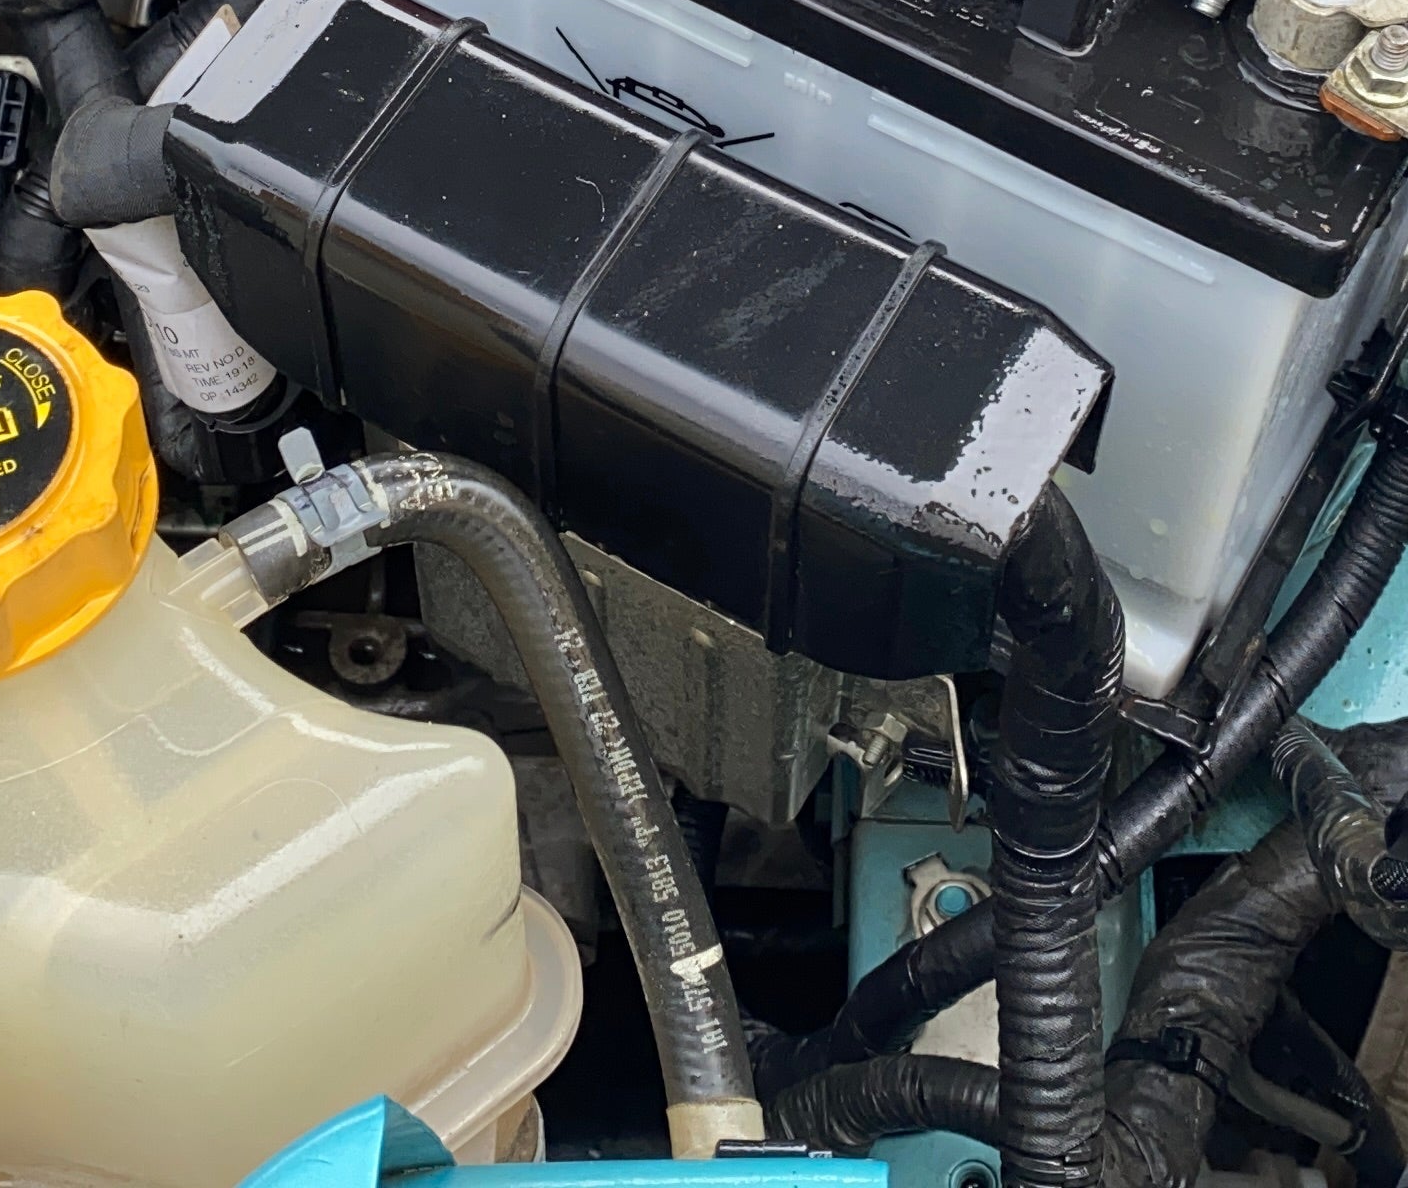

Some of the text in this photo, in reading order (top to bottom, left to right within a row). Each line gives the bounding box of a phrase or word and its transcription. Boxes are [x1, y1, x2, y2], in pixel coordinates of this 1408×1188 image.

[3, 347, 56, 403] CLOSE
[185, 361, 210, 374] REV
[650, 855, 680, 904] 5813
[660, 908, 694, 959] 5010
